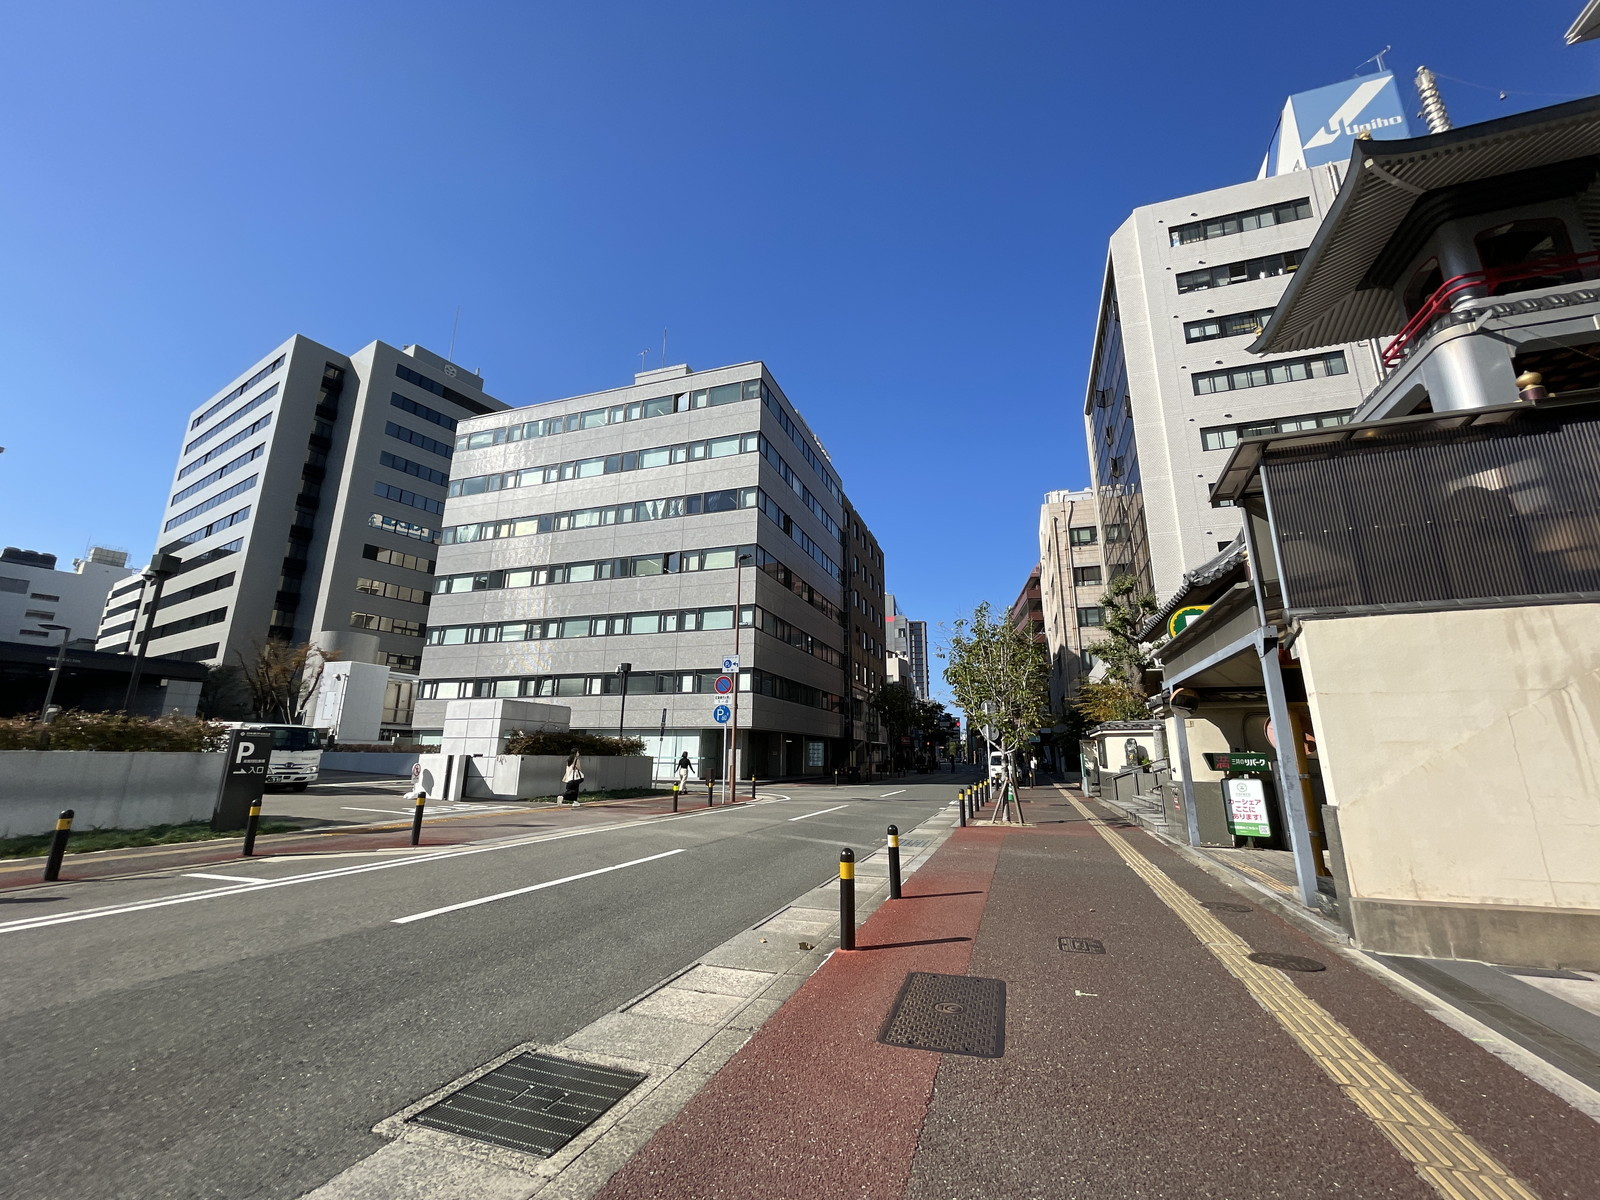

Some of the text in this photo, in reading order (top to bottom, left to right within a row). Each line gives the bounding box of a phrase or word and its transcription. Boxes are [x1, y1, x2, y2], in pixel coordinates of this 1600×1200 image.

[1345, 115, 1402, 135] Uniho
[717, 709, 724, 721] P
[236, 742, 254, 763] P
[248, 766, 264, 774] 入口
